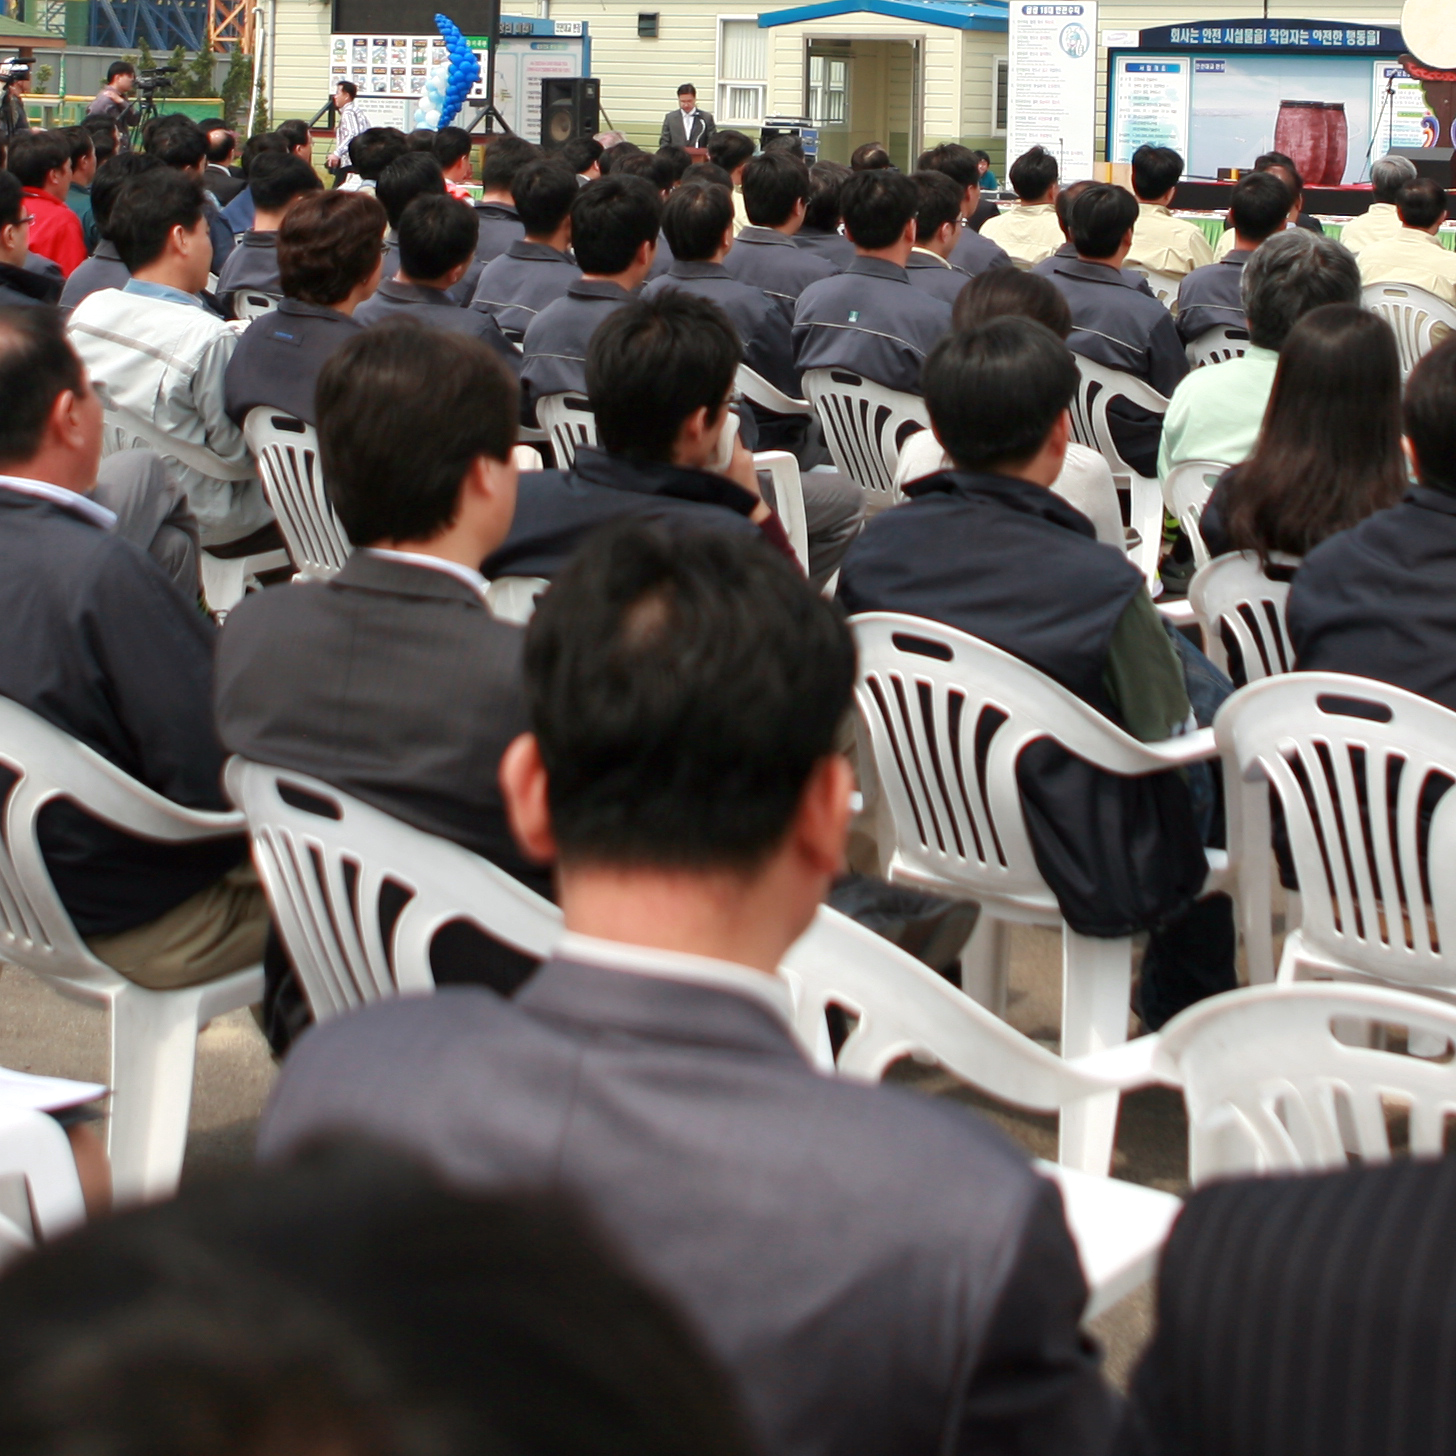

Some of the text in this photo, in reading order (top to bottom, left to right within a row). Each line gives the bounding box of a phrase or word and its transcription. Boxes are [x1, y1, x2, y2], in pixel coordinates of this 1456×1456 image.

[1169, 27, 1200, 44] 회사는
[1202, 28, 1222, 44] 안전
[1269, 28, 1310, 45] 작업자는
[1346, 29, 1381, 46] 행동을!
